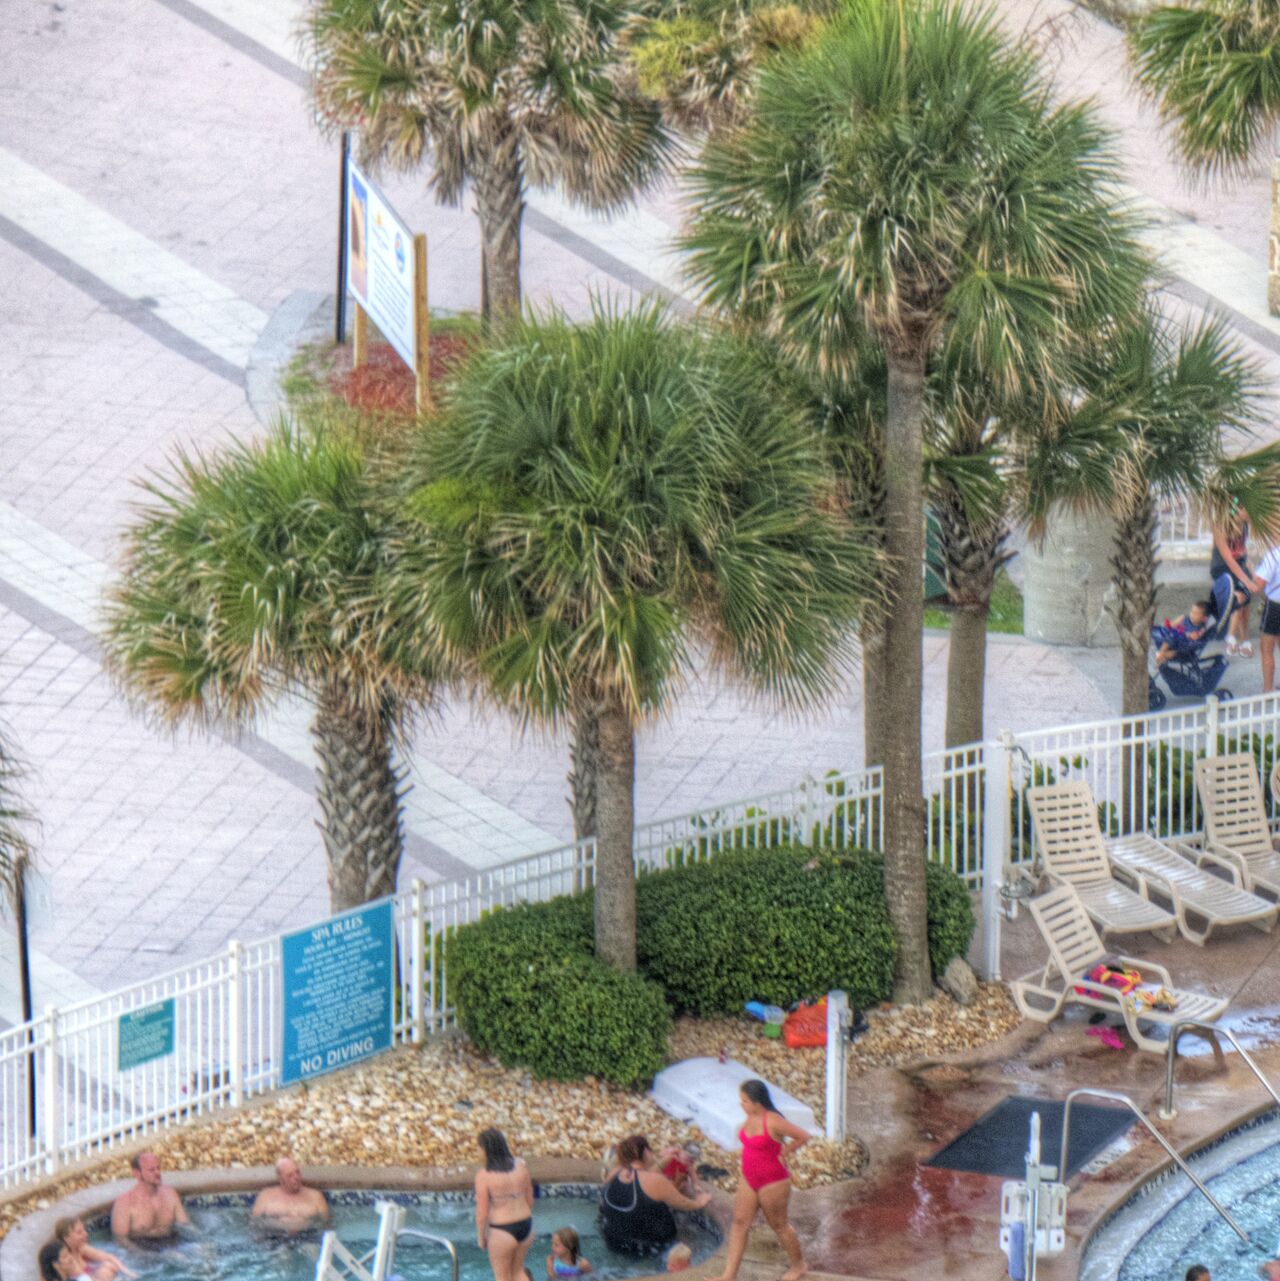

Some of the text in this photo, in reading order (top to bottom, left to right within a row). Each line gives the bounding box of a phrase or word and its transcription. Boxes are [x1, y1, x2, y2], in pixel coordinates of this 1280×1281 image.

[311, 915, 364, 943] SPA RULES
[300, 1037, 375, 1074] NO DIVING
